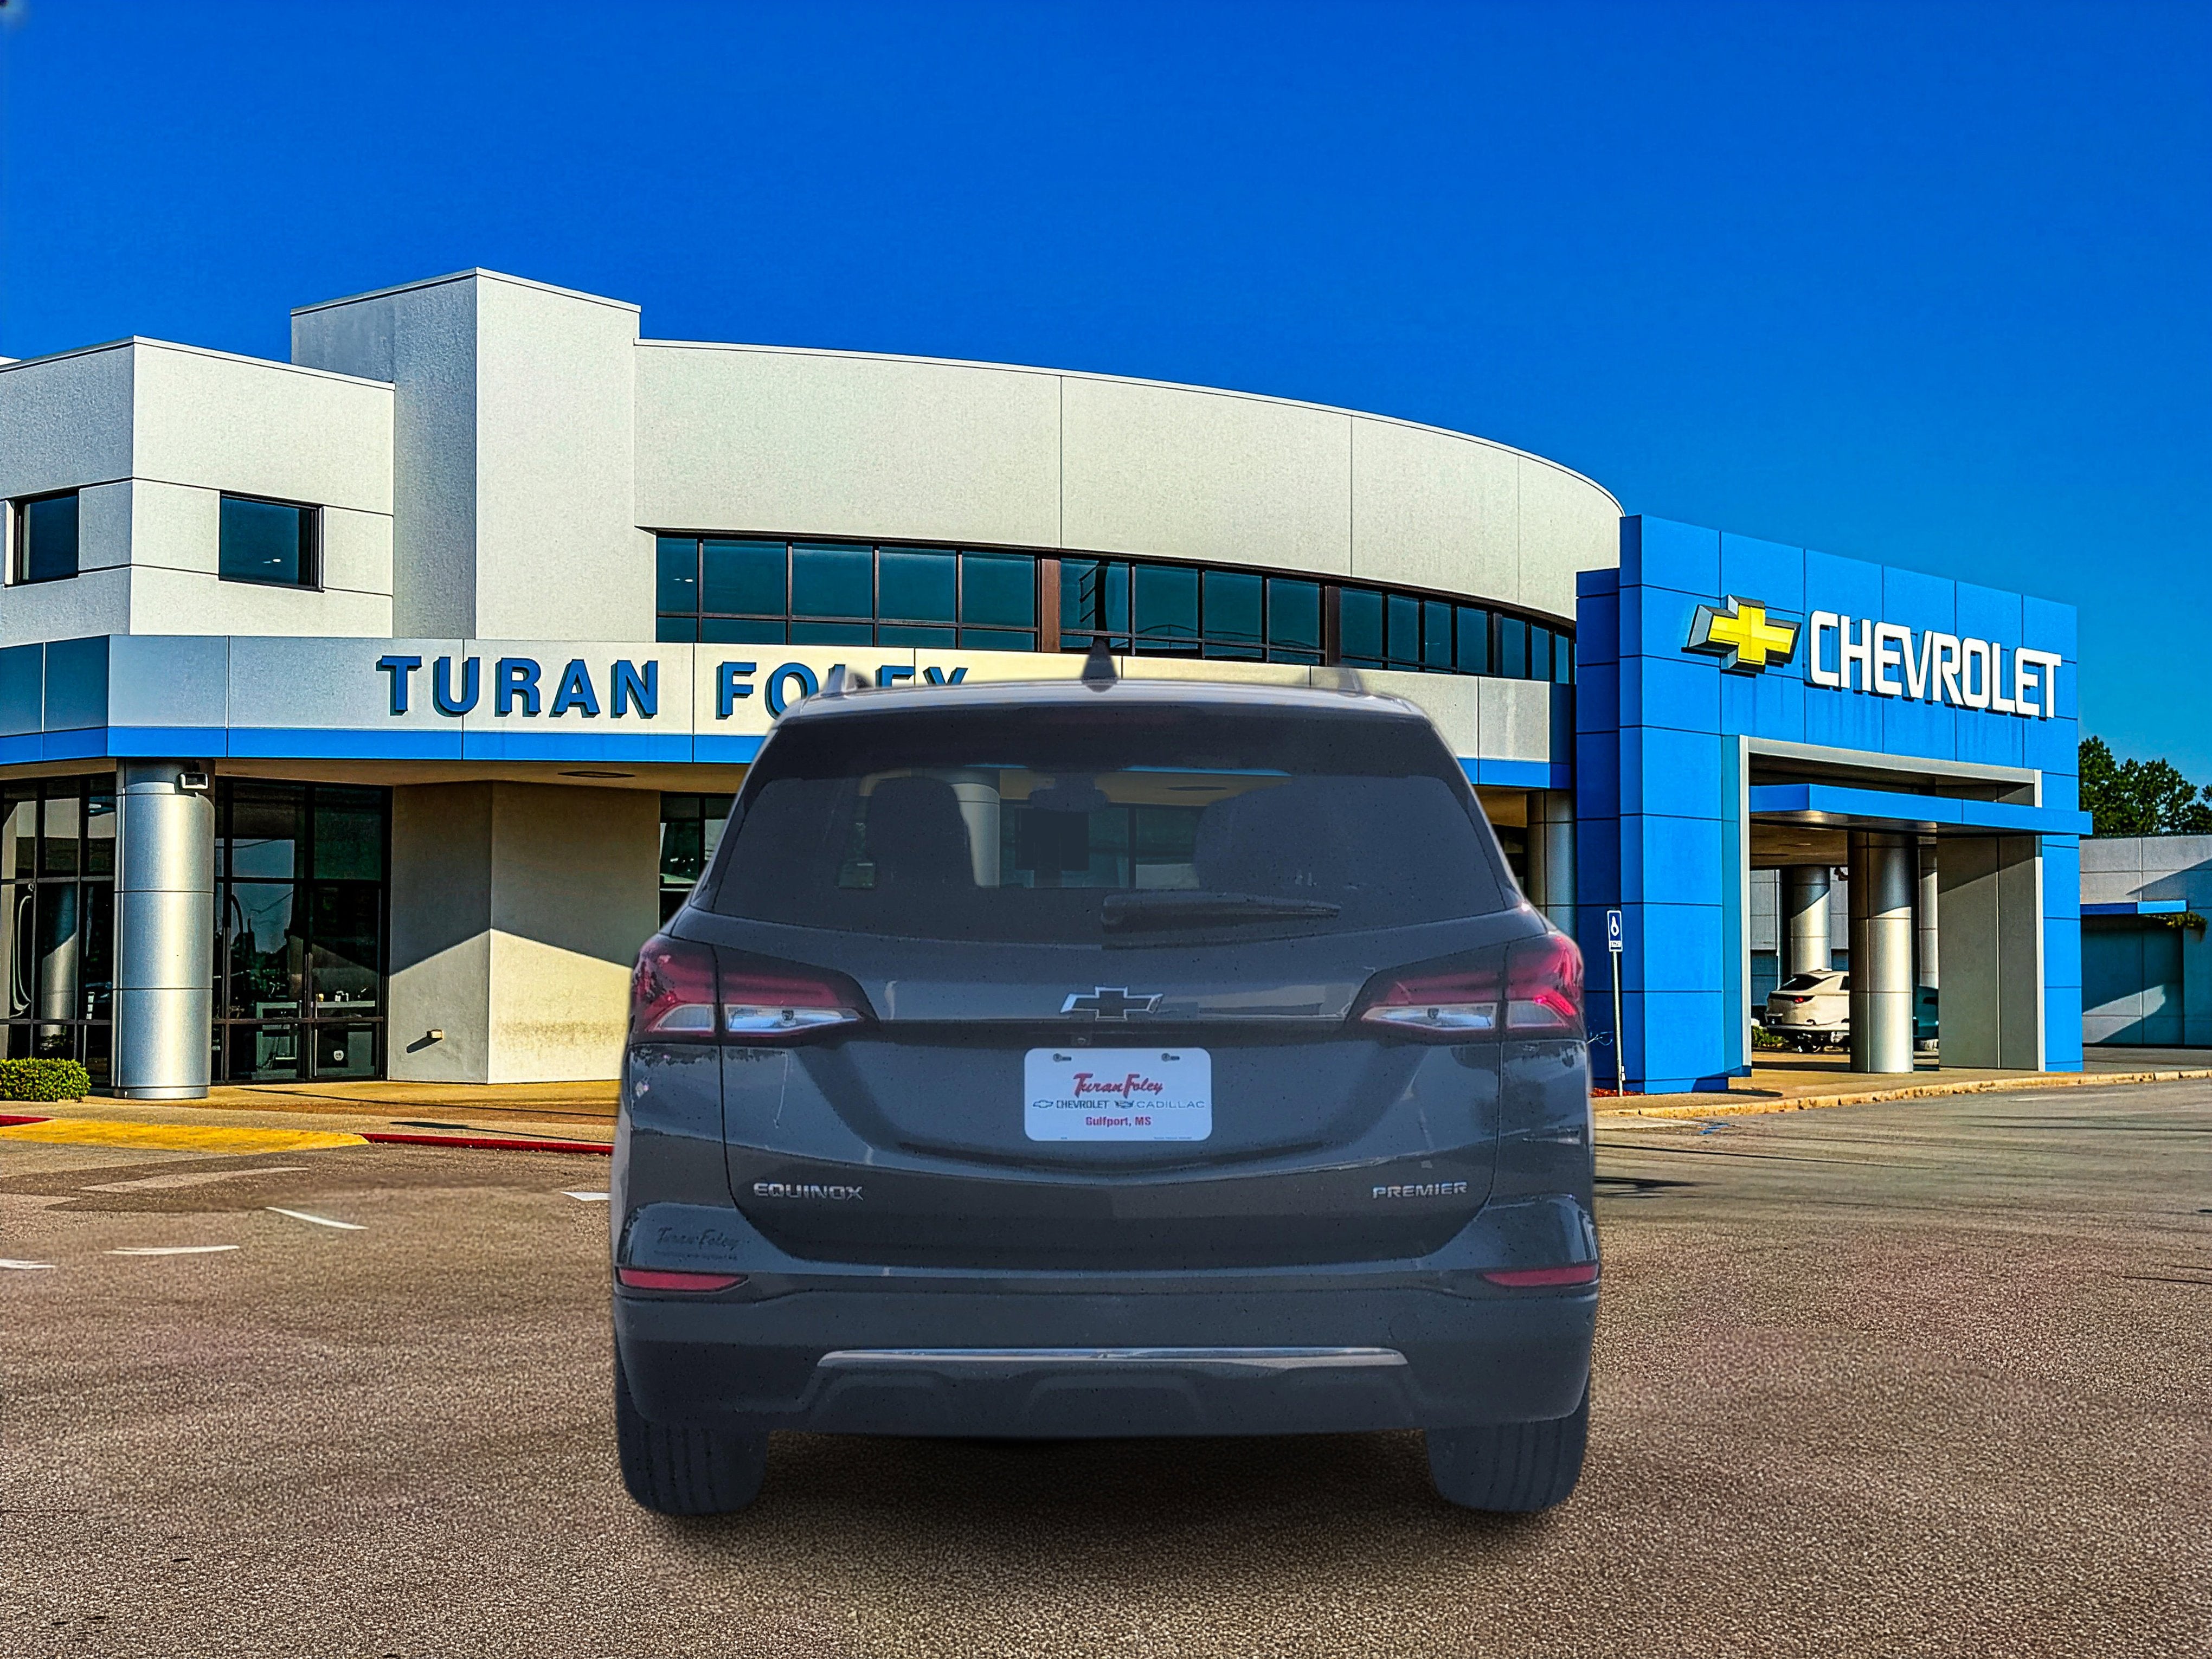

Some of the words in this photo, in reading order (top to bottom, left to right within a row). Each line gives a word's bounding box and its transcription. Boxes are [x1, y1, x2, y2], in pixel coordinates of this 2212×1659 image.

[1809, 609, 2062, 718] CHEVROLET
[376, 655, 659, 719] TURAN
[1056, 1100, 1109, 1109] CHEVROLET
[1136, 1101, 1205, 1109] CADILLAC
[1085, 1116, 1132, 1127] Gulfport,
[1134, 1116, 1152, 1126] MS
[753, 1182, 864, 1201] EQUINOX
[1372, 1181, 1467, 1199] PREMIER
